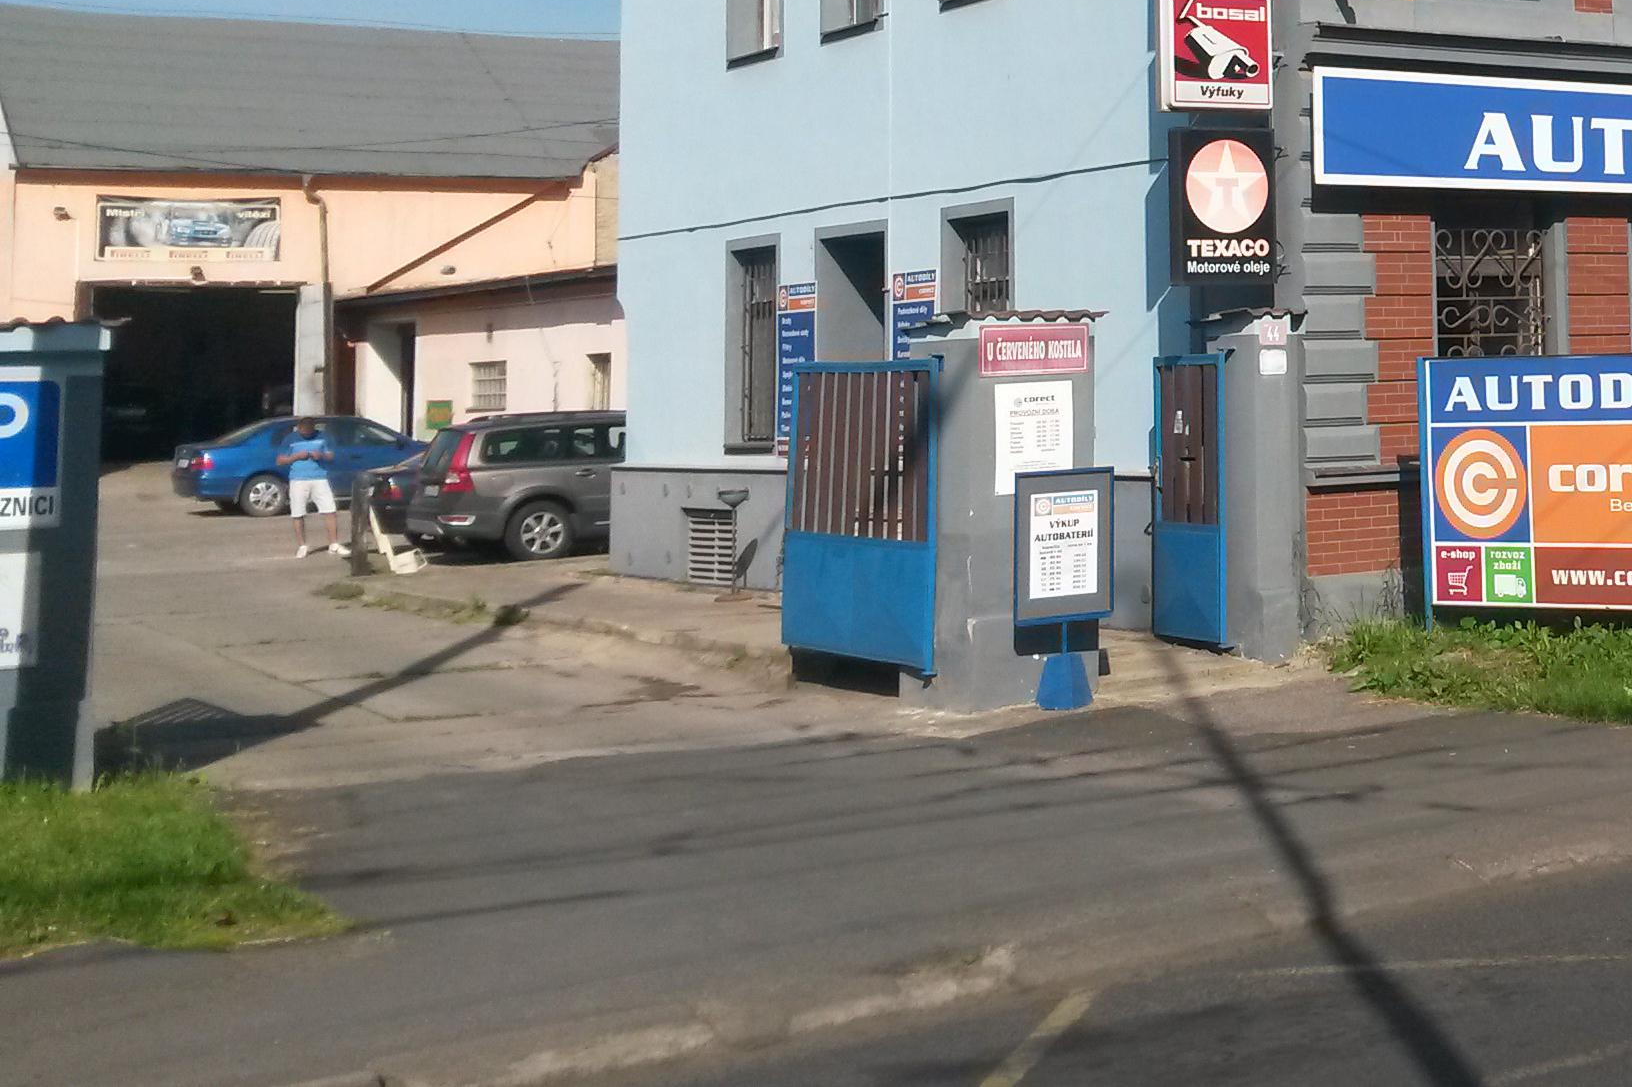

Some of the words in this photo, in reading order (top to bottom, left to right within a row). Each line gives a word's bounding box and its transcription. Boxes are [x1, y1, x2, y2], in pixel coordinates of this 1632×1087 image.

[1196, 2, 1265, 22] bosal
[1200, 85, 1244, 99] Výfuky
[1186, 239, 1270, 258] TEXACO
[1187, 260, 1240, 274] Motorové
[1244, 260, 1270, 276] oleje
[1266, 326, 1280, 341] 44
[987, 342, 994, 361] U
[996, 336, 1045, 361] ČERVENÉHO
[1048, 340, 1082, 358] KOSTELA
[1050, 518, 1079, 528] VÝKUP
[1440, 548, 1476, 562] e-shop
[1490, 550, 1525, 560] rozvoz
[1493, 560, 1521, 571] zboží
